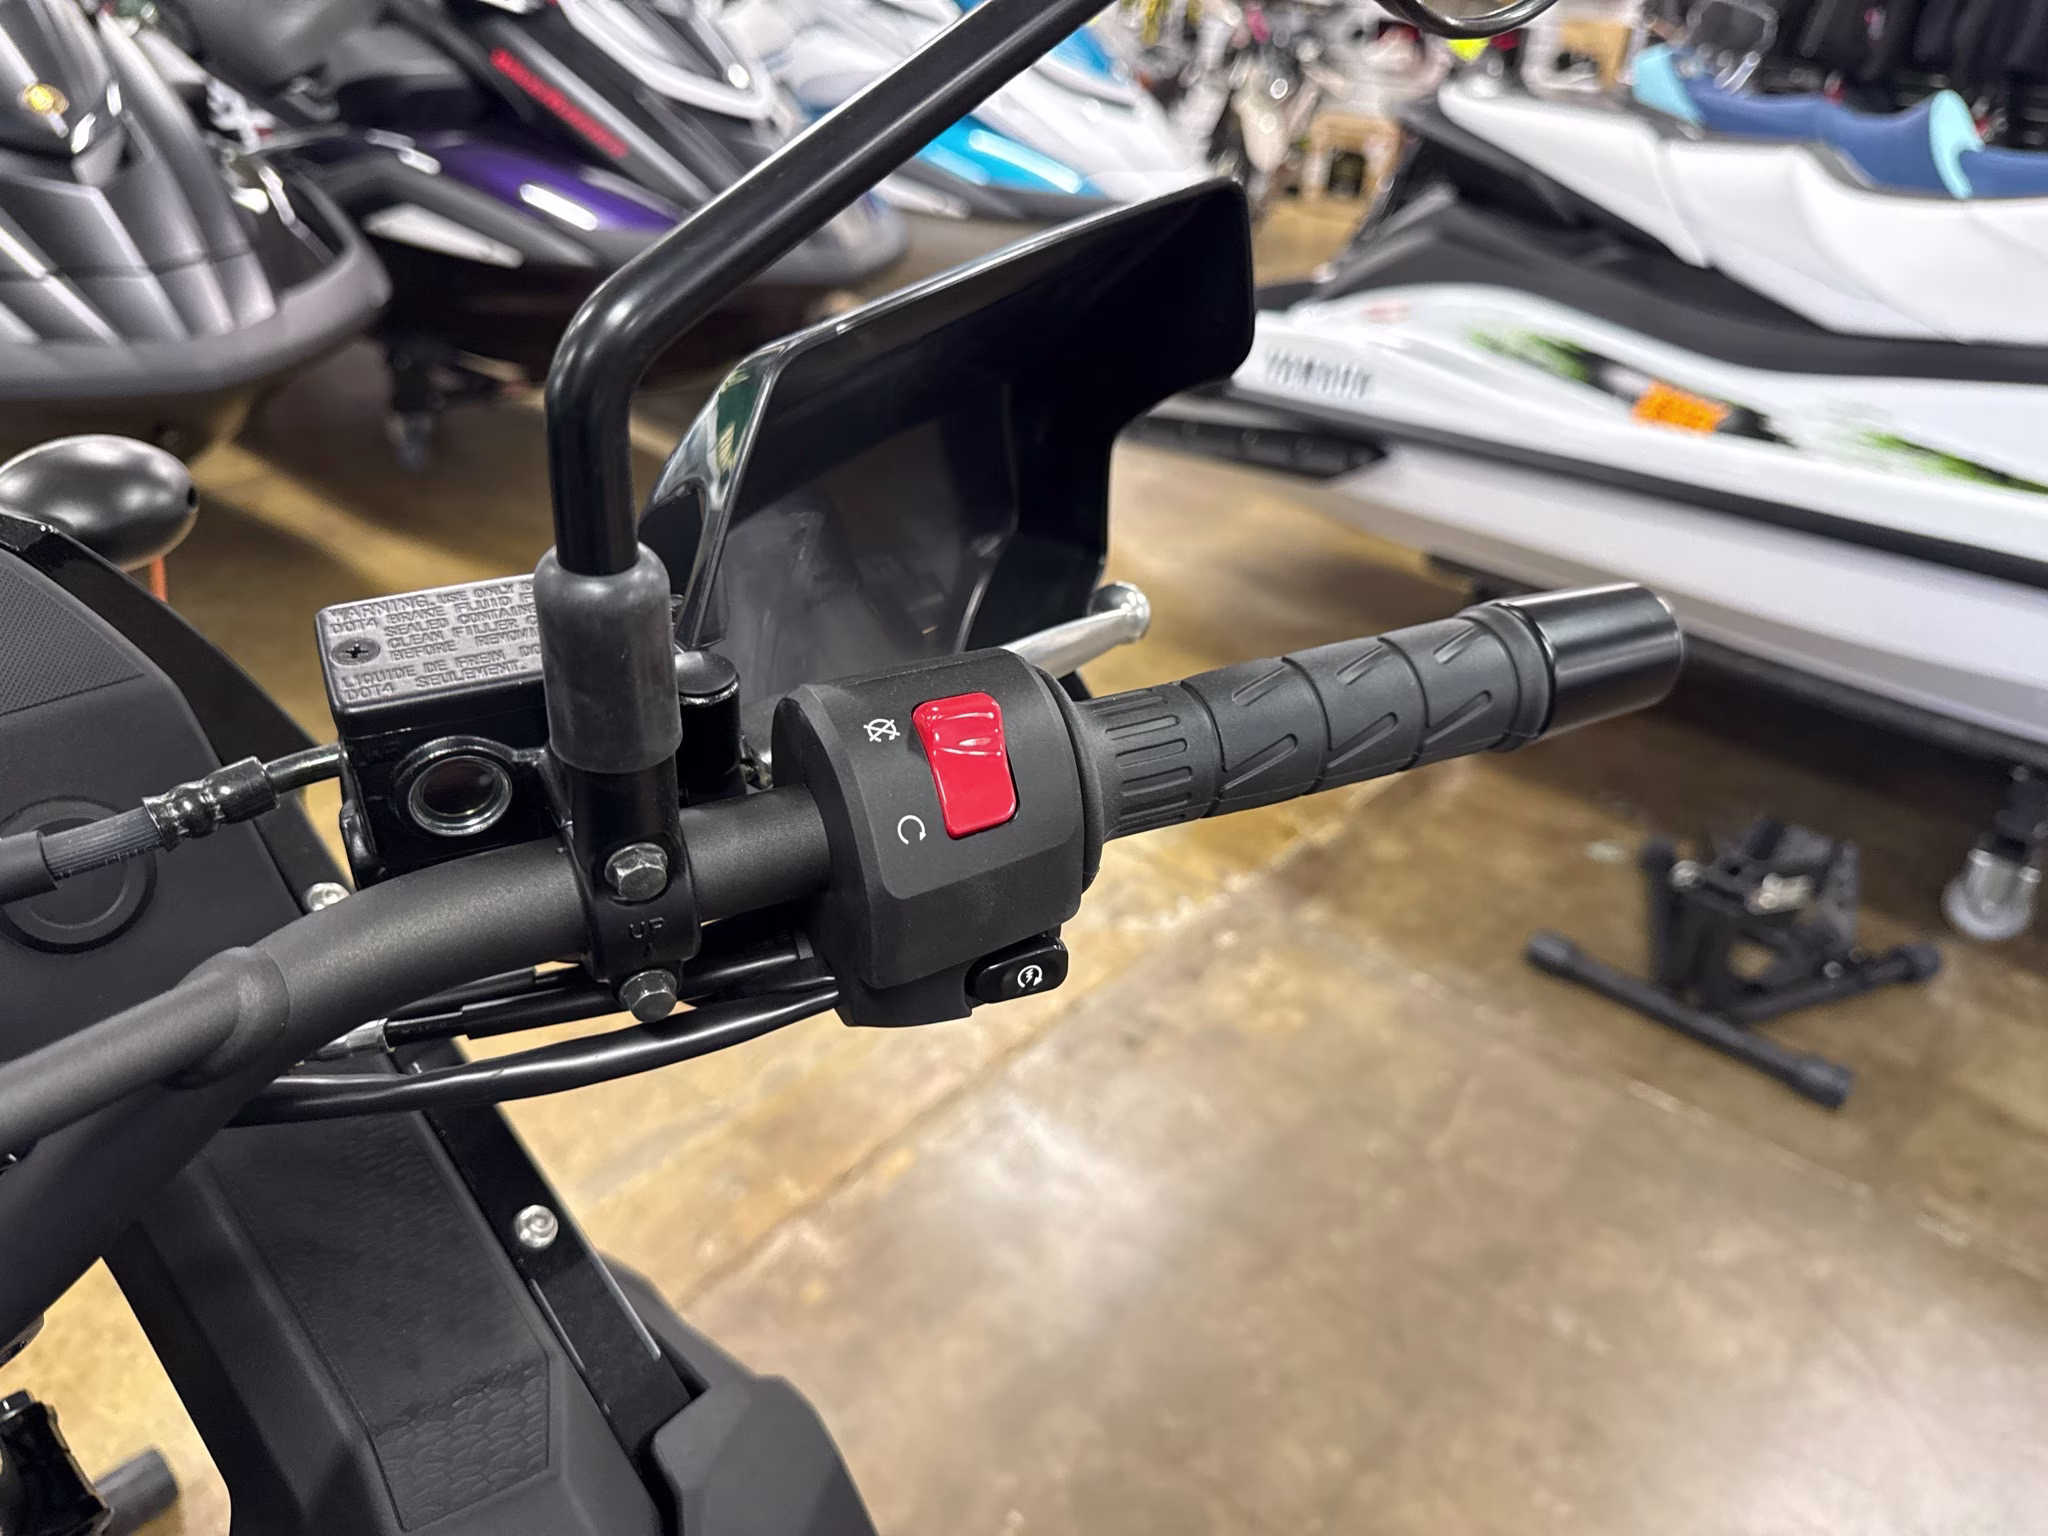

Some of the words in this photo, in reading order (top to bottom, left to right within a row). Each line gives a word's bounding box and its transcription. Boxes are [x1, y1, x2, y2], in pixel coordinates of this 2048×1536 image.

[437, 591, 469, 604] USE
[474, 584, 514, 598] ONLY
[330, 617, 379, 634] DOT4
[386, 606, 447, 624] BRAKE
[454, 596, 512, 613] FLUID
[384, 617, 449, 637] SEALED
[457, 603, 537, 624] CONTAINE
[388, 630, 445, 648] CLEAN
[452, 618, 519, 637] FILLER
[389, 639, 457, 661] BEFORE
[341, 665, 416, 688] LIQUIDE
[423, 659, 448, 673] DE
[454, 649, 506, 667] FREIN
[344, 681, 394, 700] DOT4
[629, 917, 665, 938] UP
